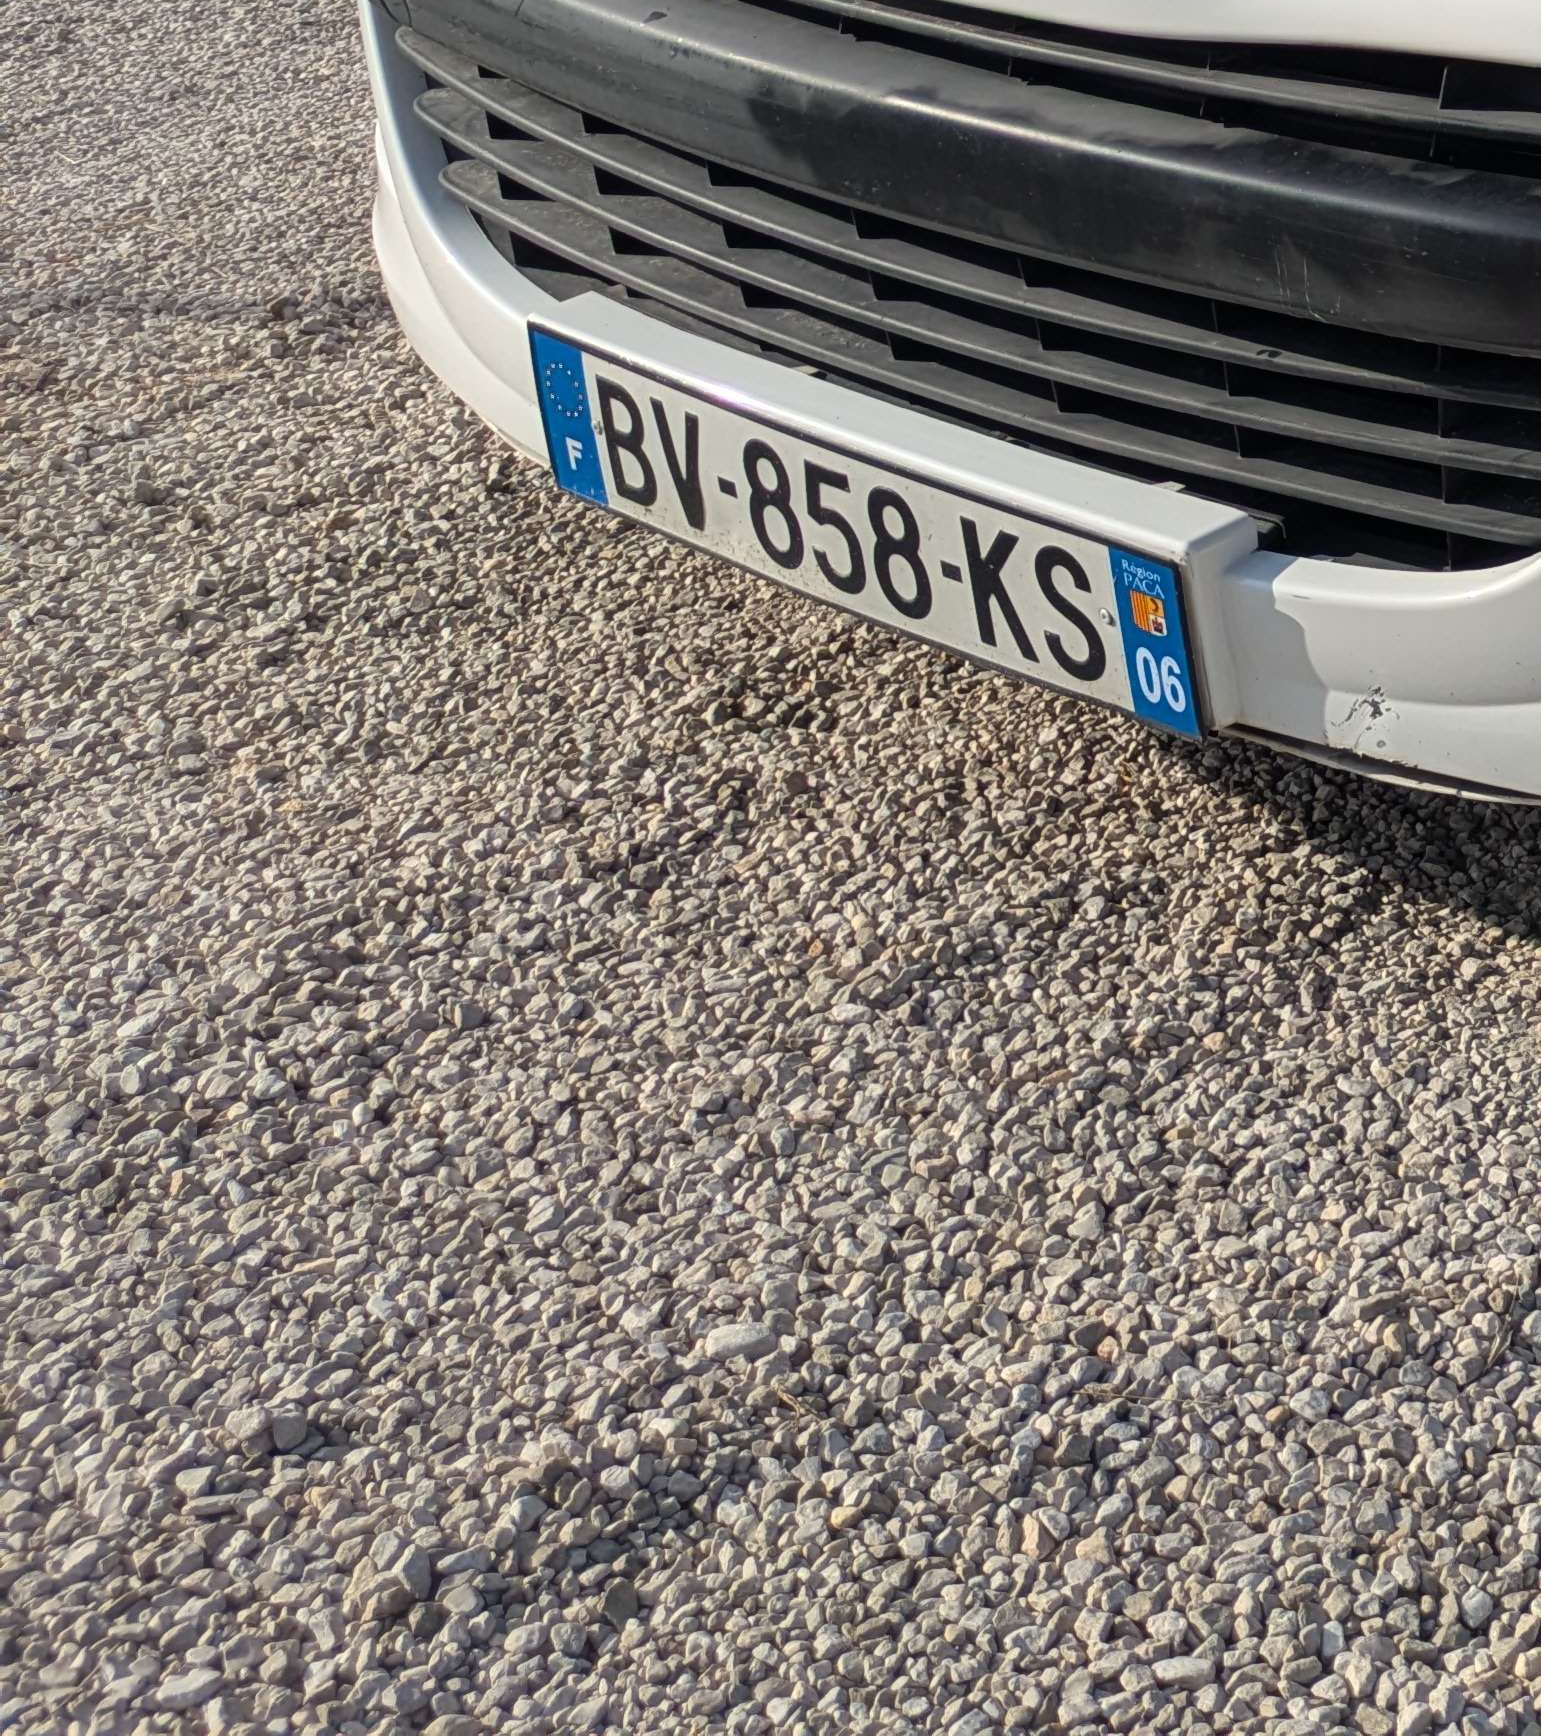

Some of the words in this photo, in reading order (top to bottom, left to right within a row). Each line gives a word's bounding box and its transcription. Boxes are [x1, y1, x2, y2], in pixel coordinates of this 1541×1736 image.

[565, 436, 584, 472] F
[595, 373, 1107, 683] BV-858-KS
[1123, 572, 1166, 600] PACA
[1135, 646, 1187, 713] 06
